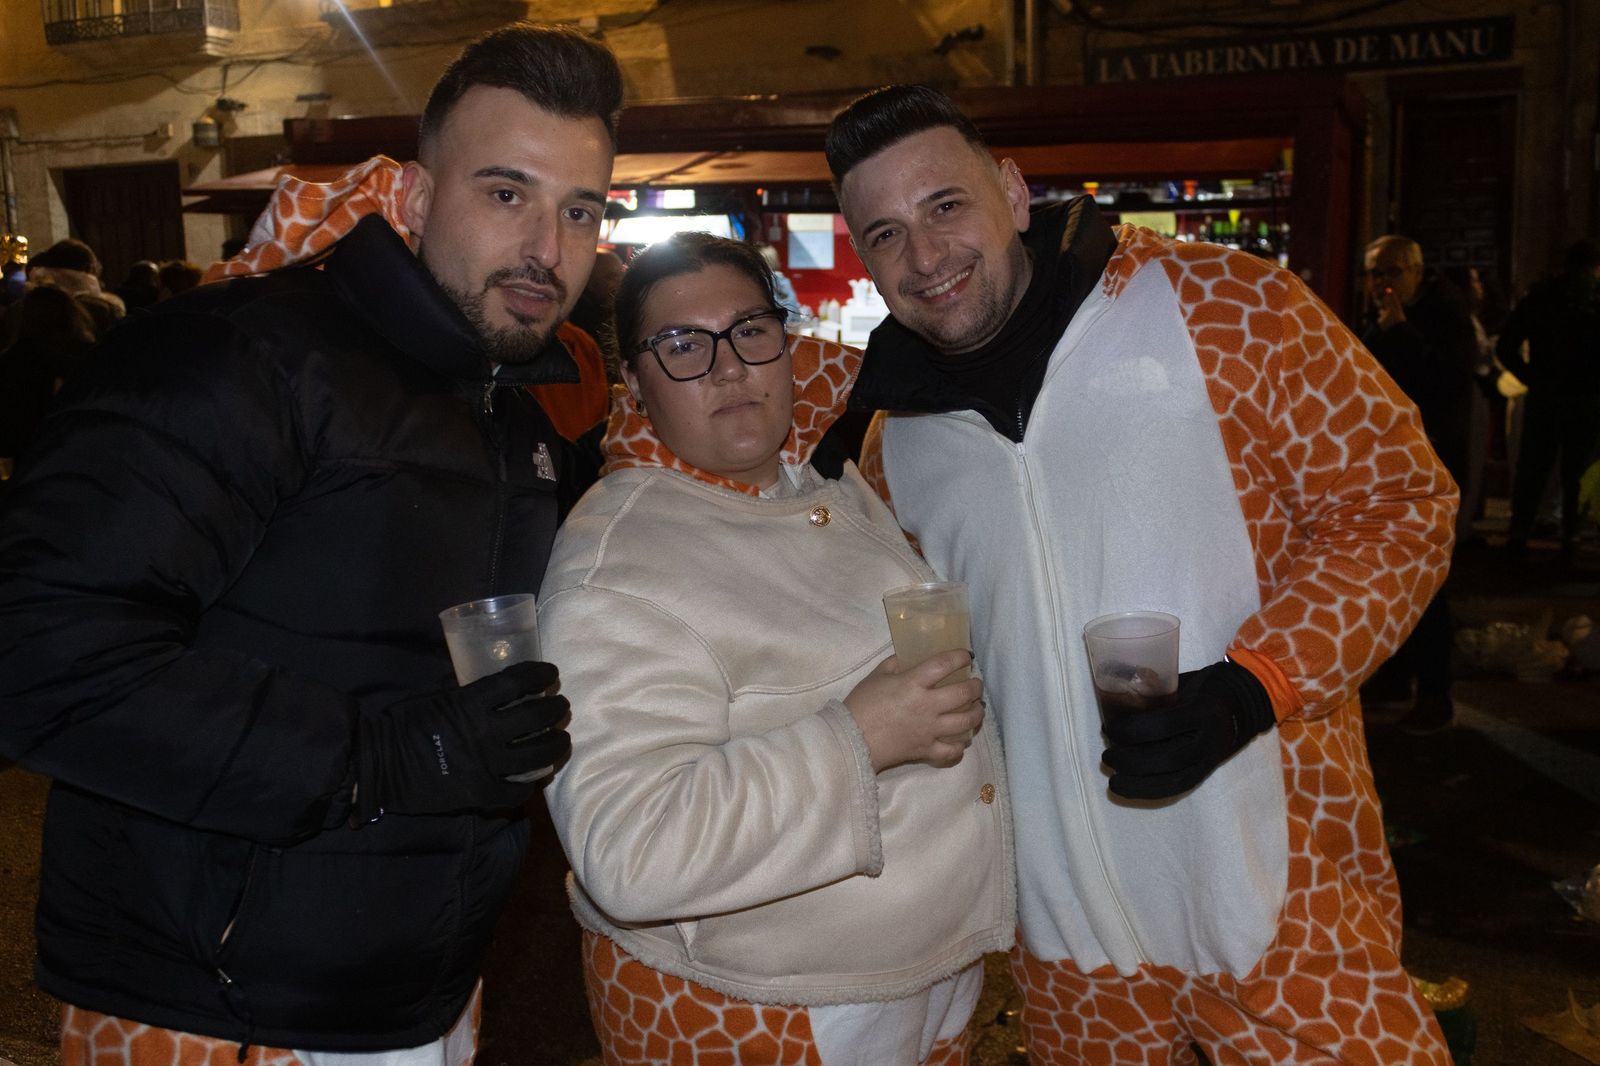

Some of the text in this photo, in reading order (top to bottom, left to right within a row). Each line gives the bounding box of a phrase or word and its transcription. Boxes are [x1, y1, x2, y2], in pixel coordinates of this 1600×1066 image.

[1099, 28, 1496, 82] LA TABERNITA DE MANU
[432, 735, 449, 776] FORCLAZ
